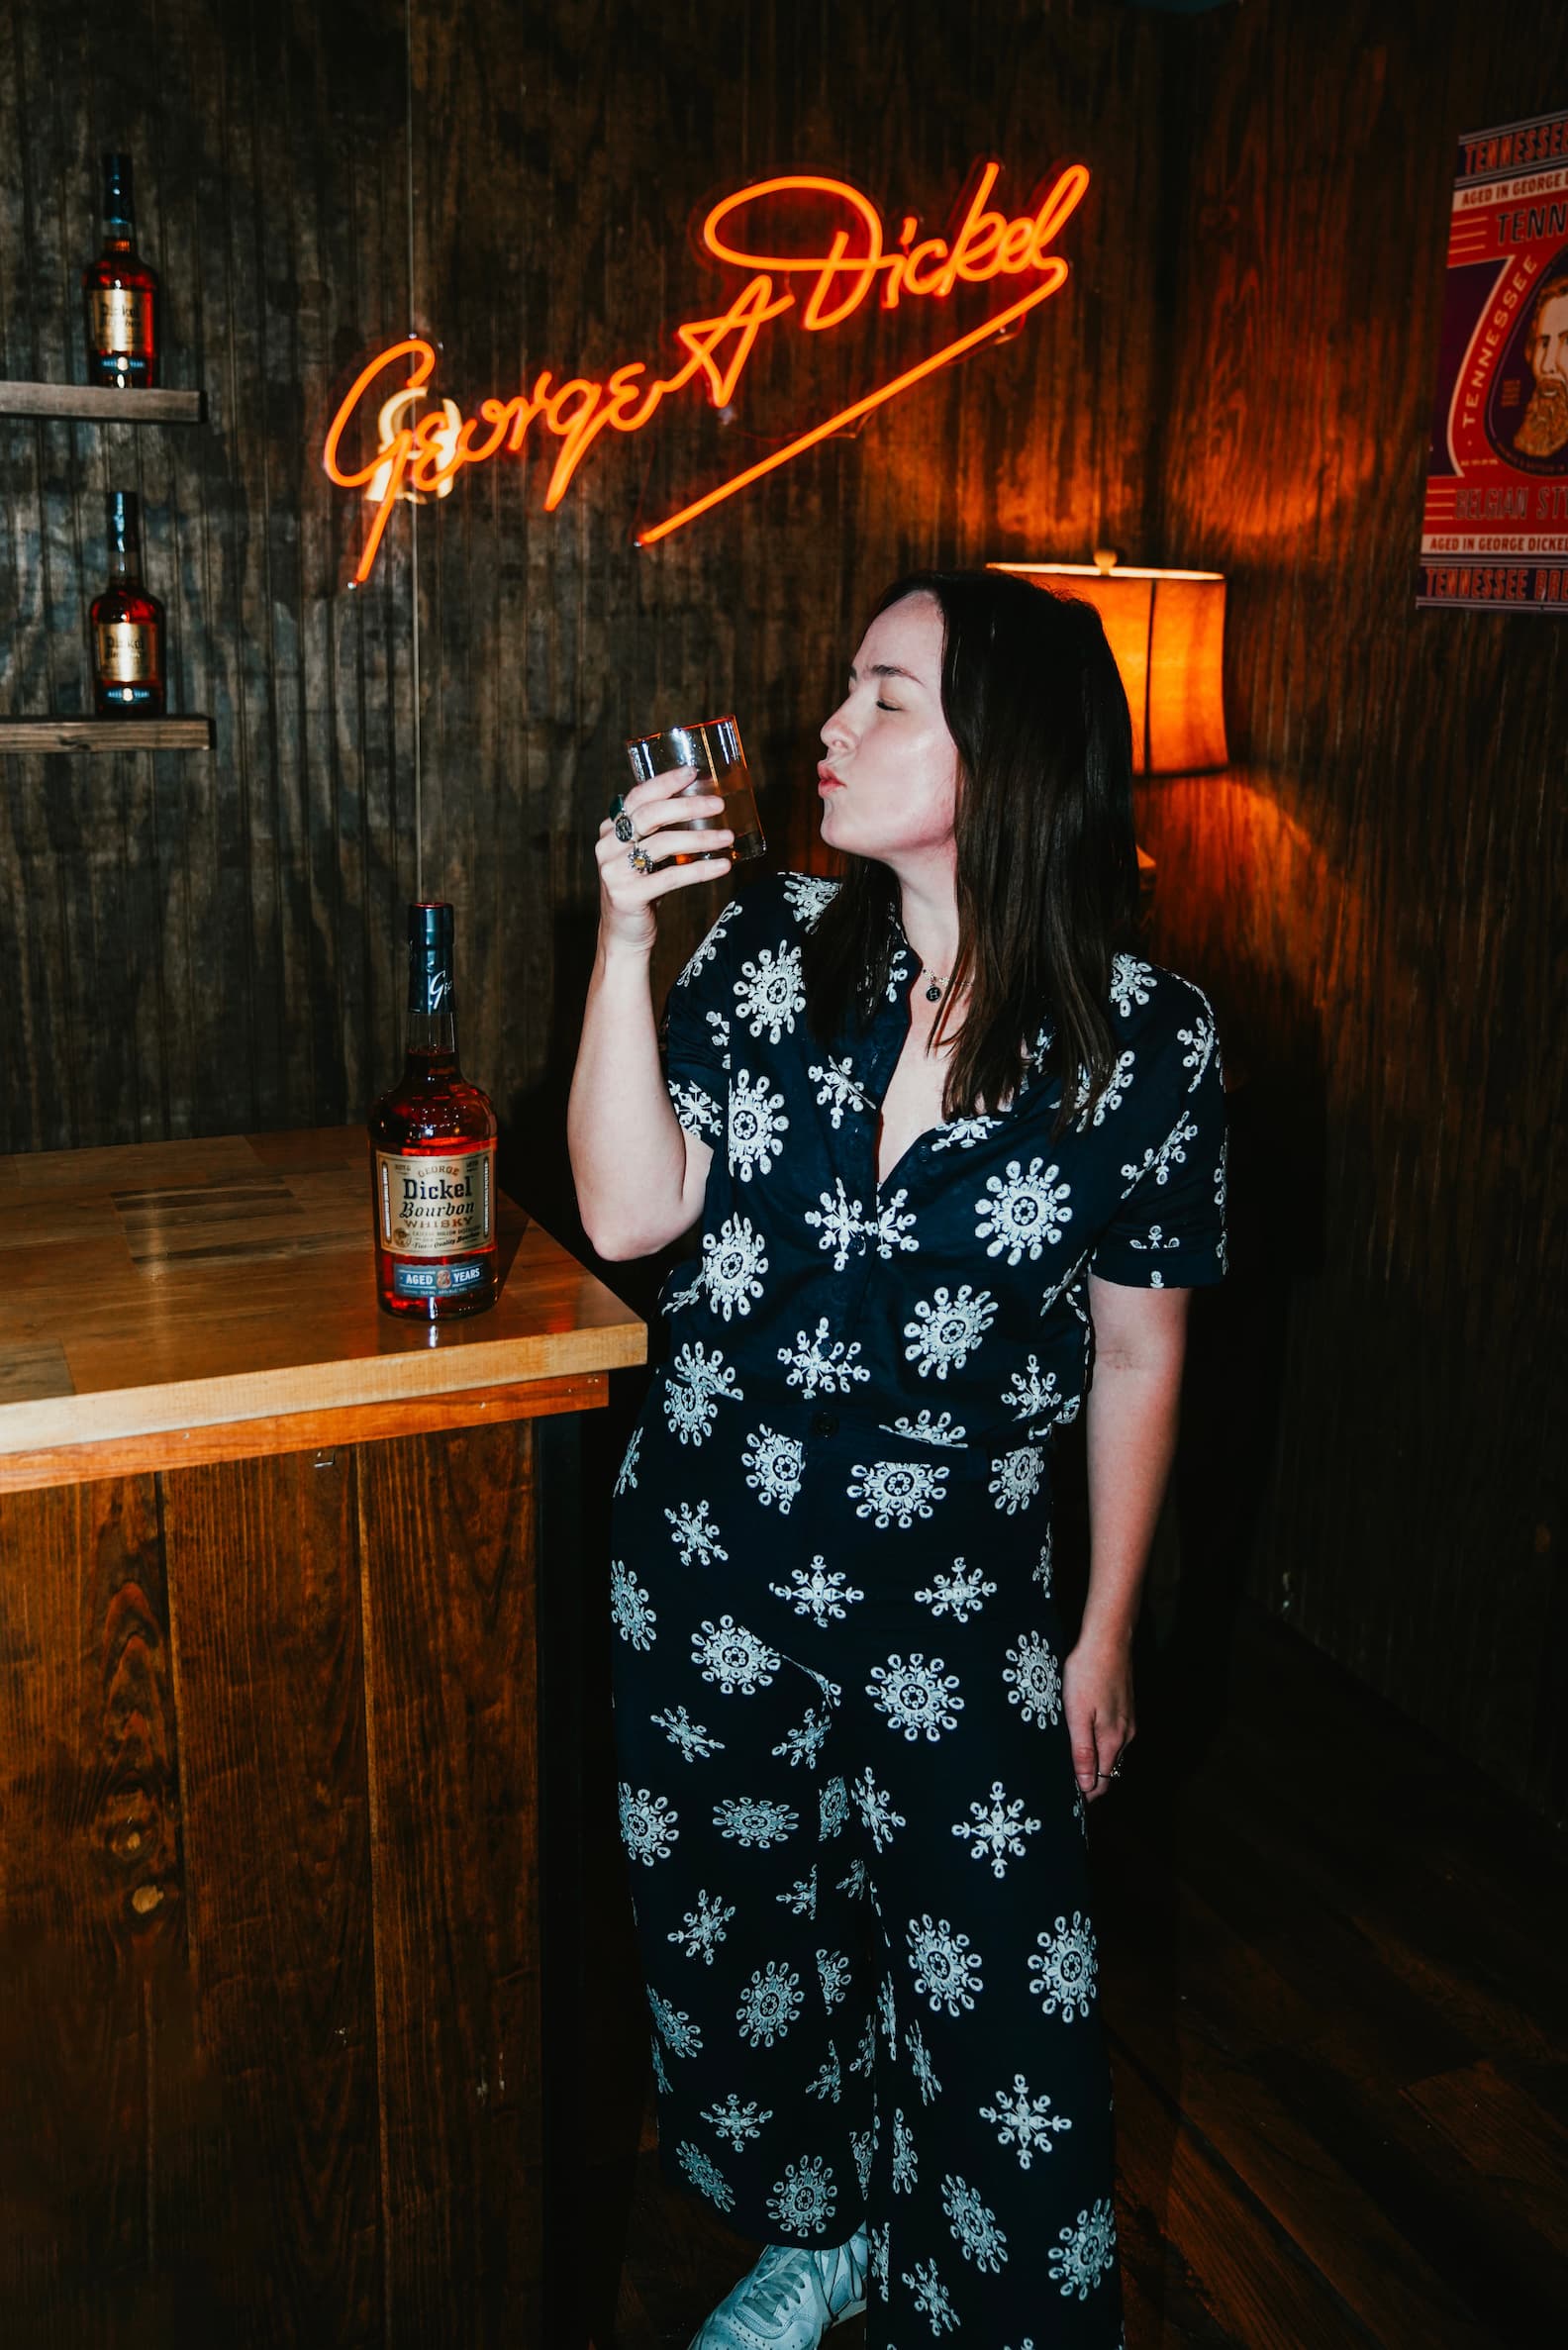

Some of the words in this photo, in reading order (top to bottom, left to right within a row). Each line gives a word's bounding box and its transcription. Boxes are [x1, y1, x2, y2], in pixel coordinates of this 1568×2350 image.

[1462, 188, 1493, 206] AGED
[1496, 184, 1510, 199] IN
[1513, 172, 1562, 196] GEORGE
[1462, 254, 1538, 429] TENNESSEE
[324, 340, 661, 584] George
[703, 162, 1090, 330] Dickel
[1455, 486, 1529, 522] BELGIAN
[1430, 538, 1459, 551] AGED
[1463, 538, 1475, 551] IN
[1479, 538, 1524, 551] GEORGE
[1426, 567, 1529, 600] TENNESSEE
[418, 1165, 460, 1178] GEORGE
[403, 1175, 473, 1200] Dickel
[399, 1201, 475, 1219] Bourbon
[404, 1216, 473, 1228] WHISKY
[405, 1274, 434, 1285] AGED
[453, 1267, 480, 1283] YEARS
